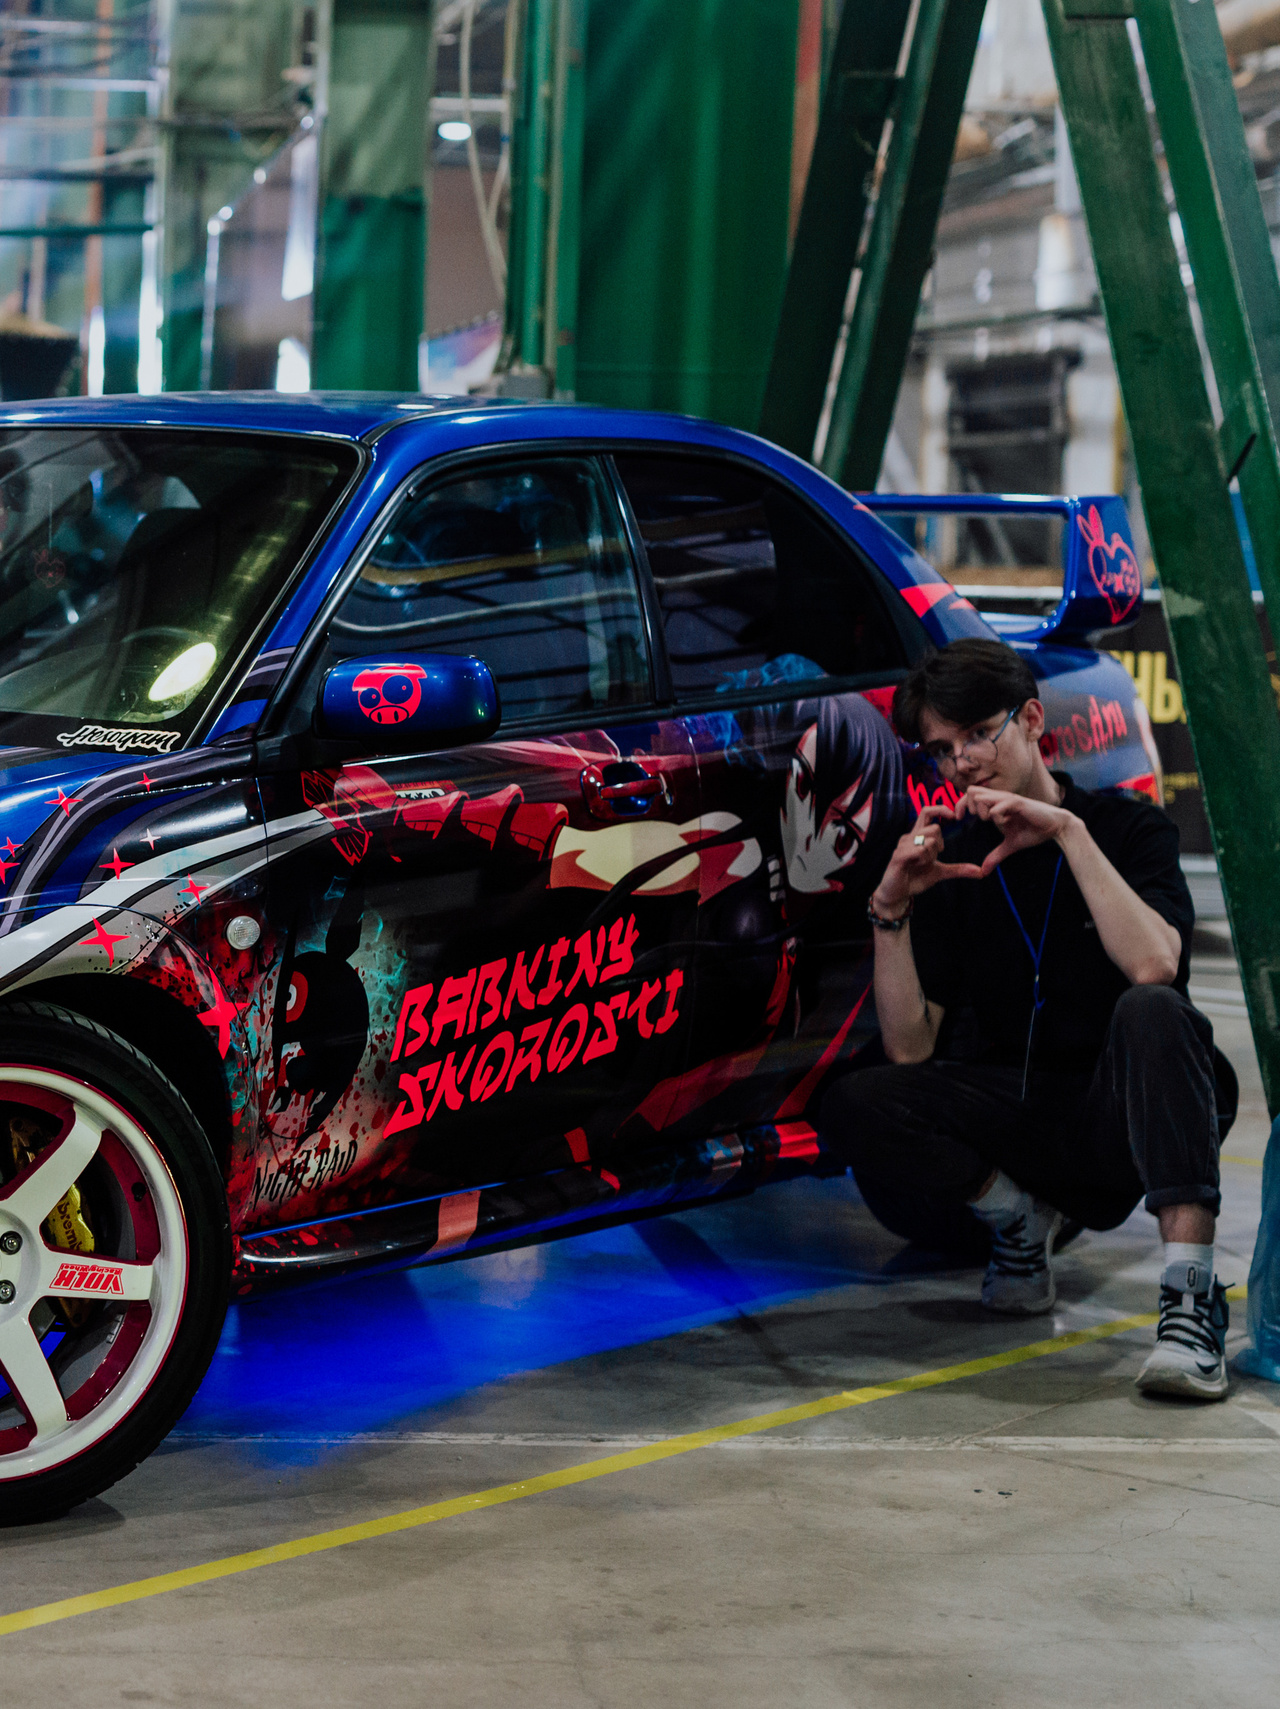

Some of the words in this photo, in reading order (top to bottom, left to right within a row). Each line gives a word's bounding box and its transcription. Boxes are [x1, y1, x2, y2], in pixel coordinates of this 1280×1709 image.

[390, 914, 639, 1062] BABKINY
[57, 1202, 83, 1251] bremb
[51, 1270, 122, 1294] VOLK
